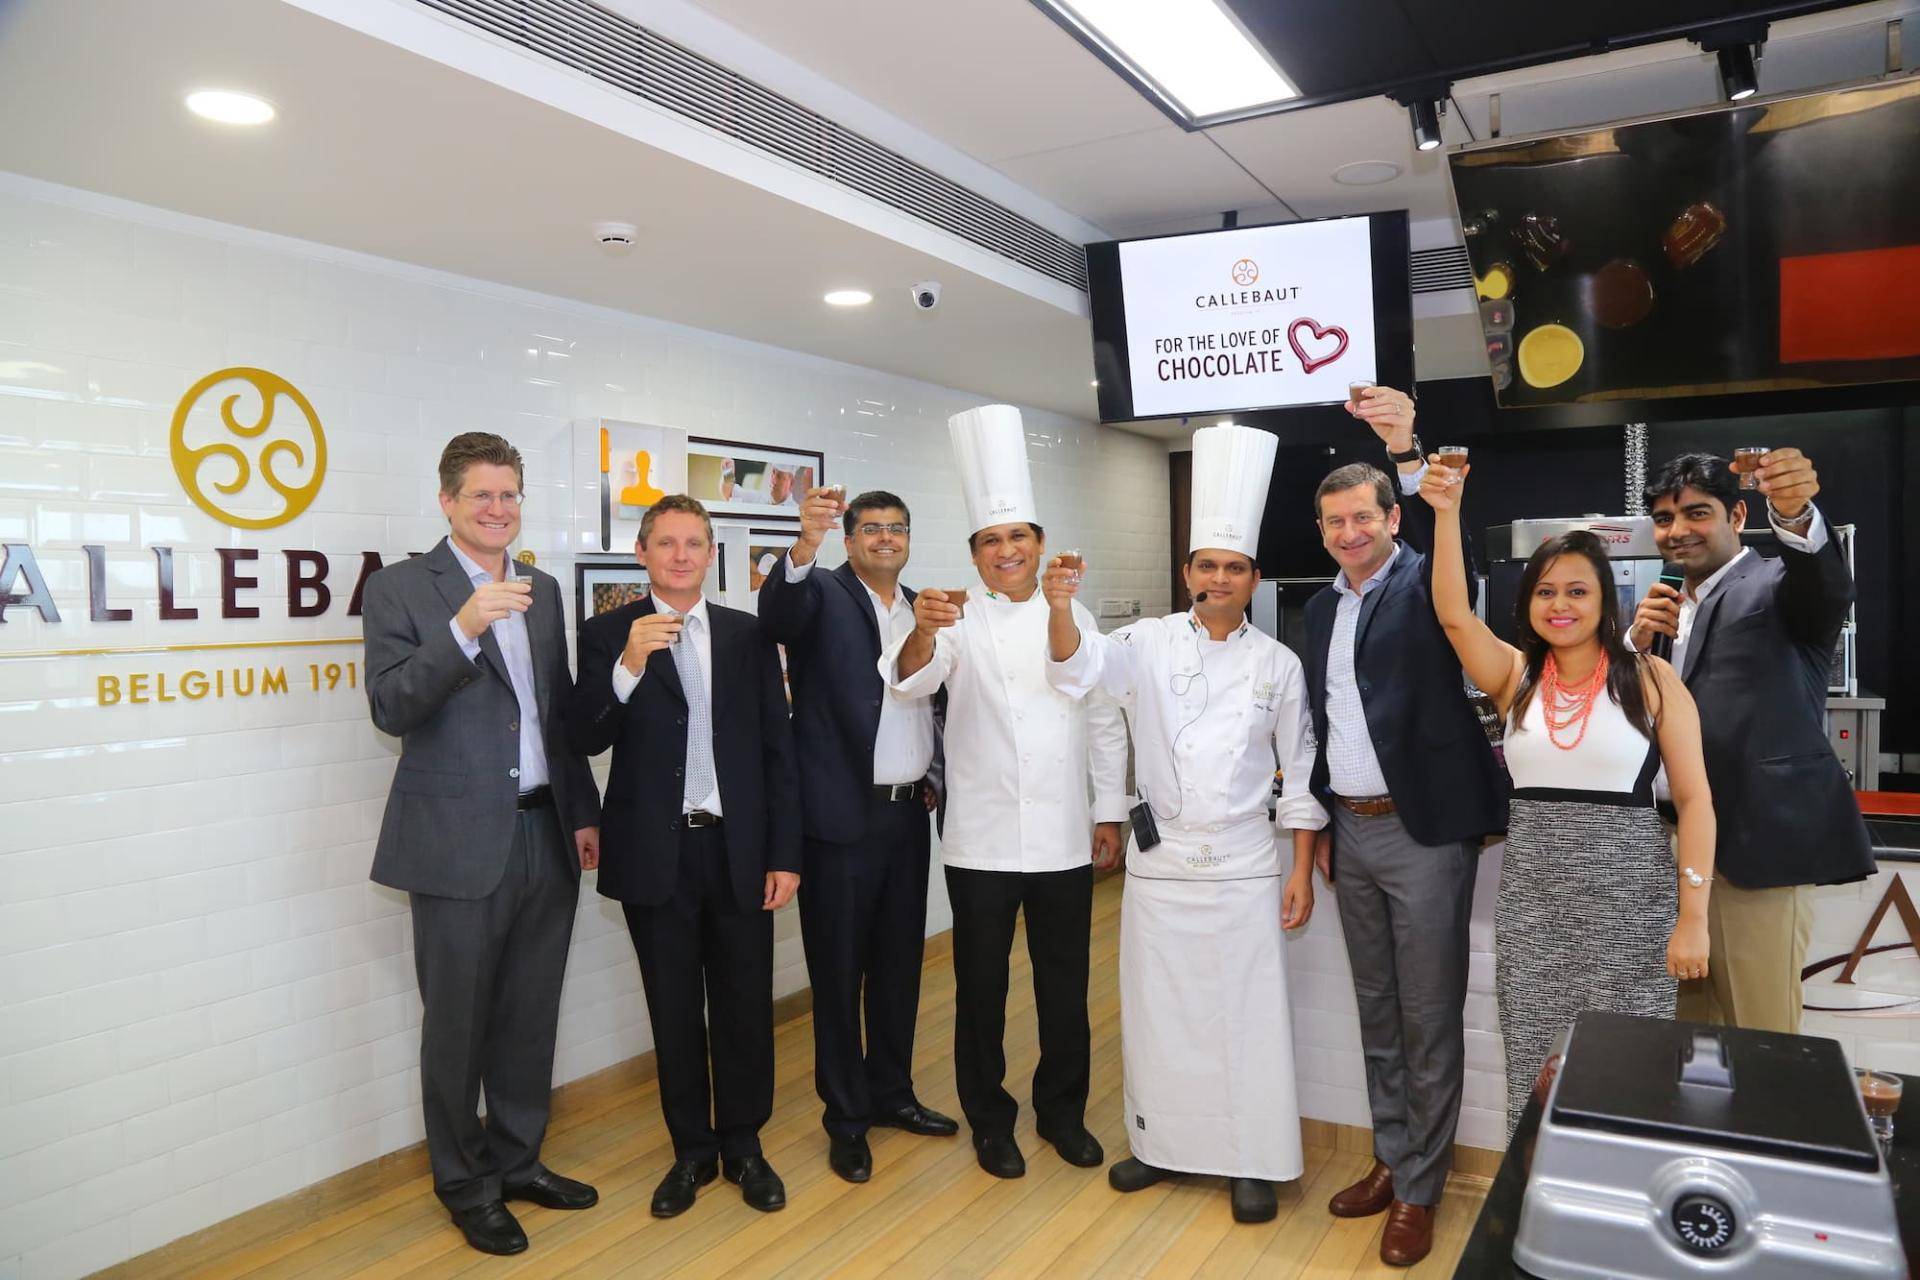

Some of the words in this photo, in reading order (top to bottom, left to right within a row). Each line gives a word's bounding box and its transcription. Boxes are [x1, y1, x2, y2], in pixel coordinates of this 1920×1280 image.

[1195, 286, 1299, 308] CALLEBAUT
[1155, 337, 1184, 354] FOR
[1187, 334, 1216, 352] THE
[1220, 330, 1257, 349] LOVE
[1261, 328, 1280, 345] OF
[1158, 349, 1284, 382] CHOCOLATE
[97, 665, 289, 707] BELGIUM
[308, 661, 366, 692] 191
